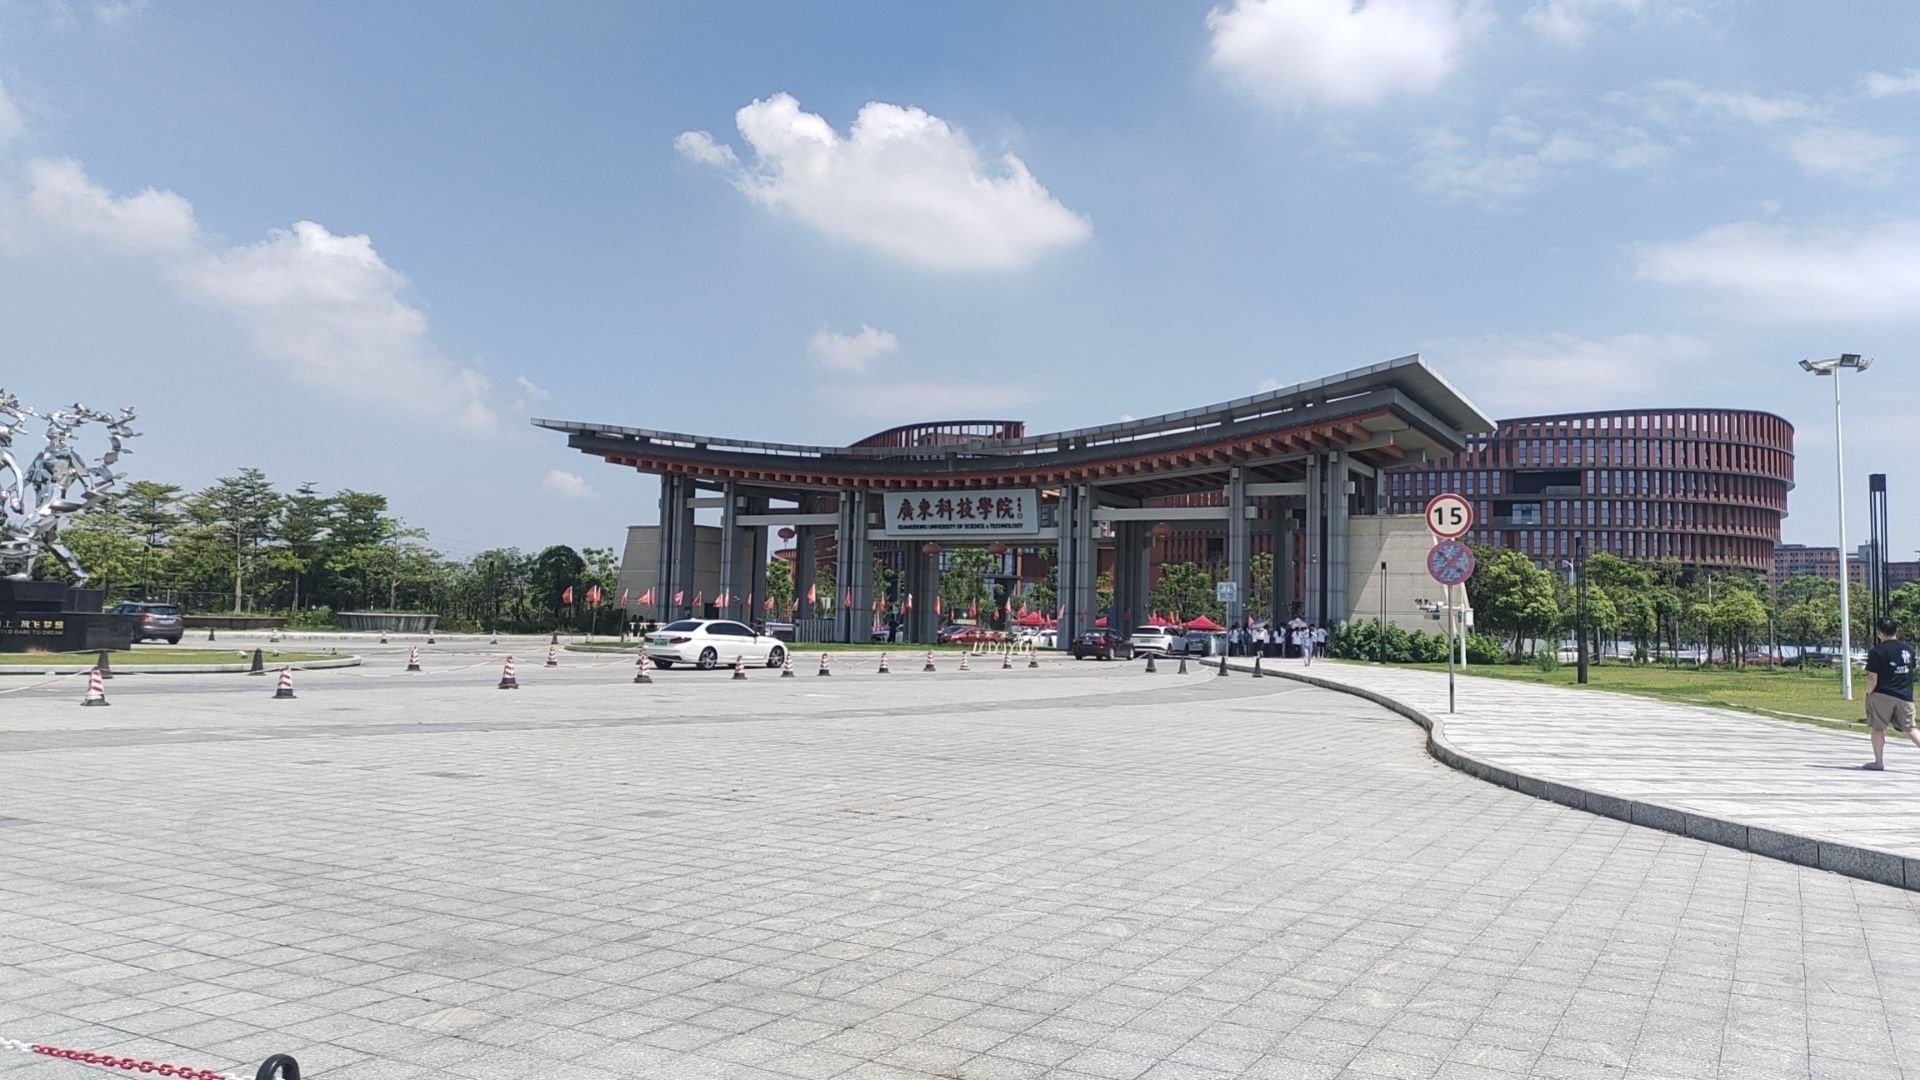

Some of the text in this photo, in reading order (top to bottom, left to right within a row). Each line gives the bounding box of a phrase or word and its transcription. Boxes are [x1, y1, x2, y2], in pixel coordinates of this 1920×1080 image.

[897, 497, 1014, 521] 廣東科技學院
[1434, 506, 1462, 525] 15
